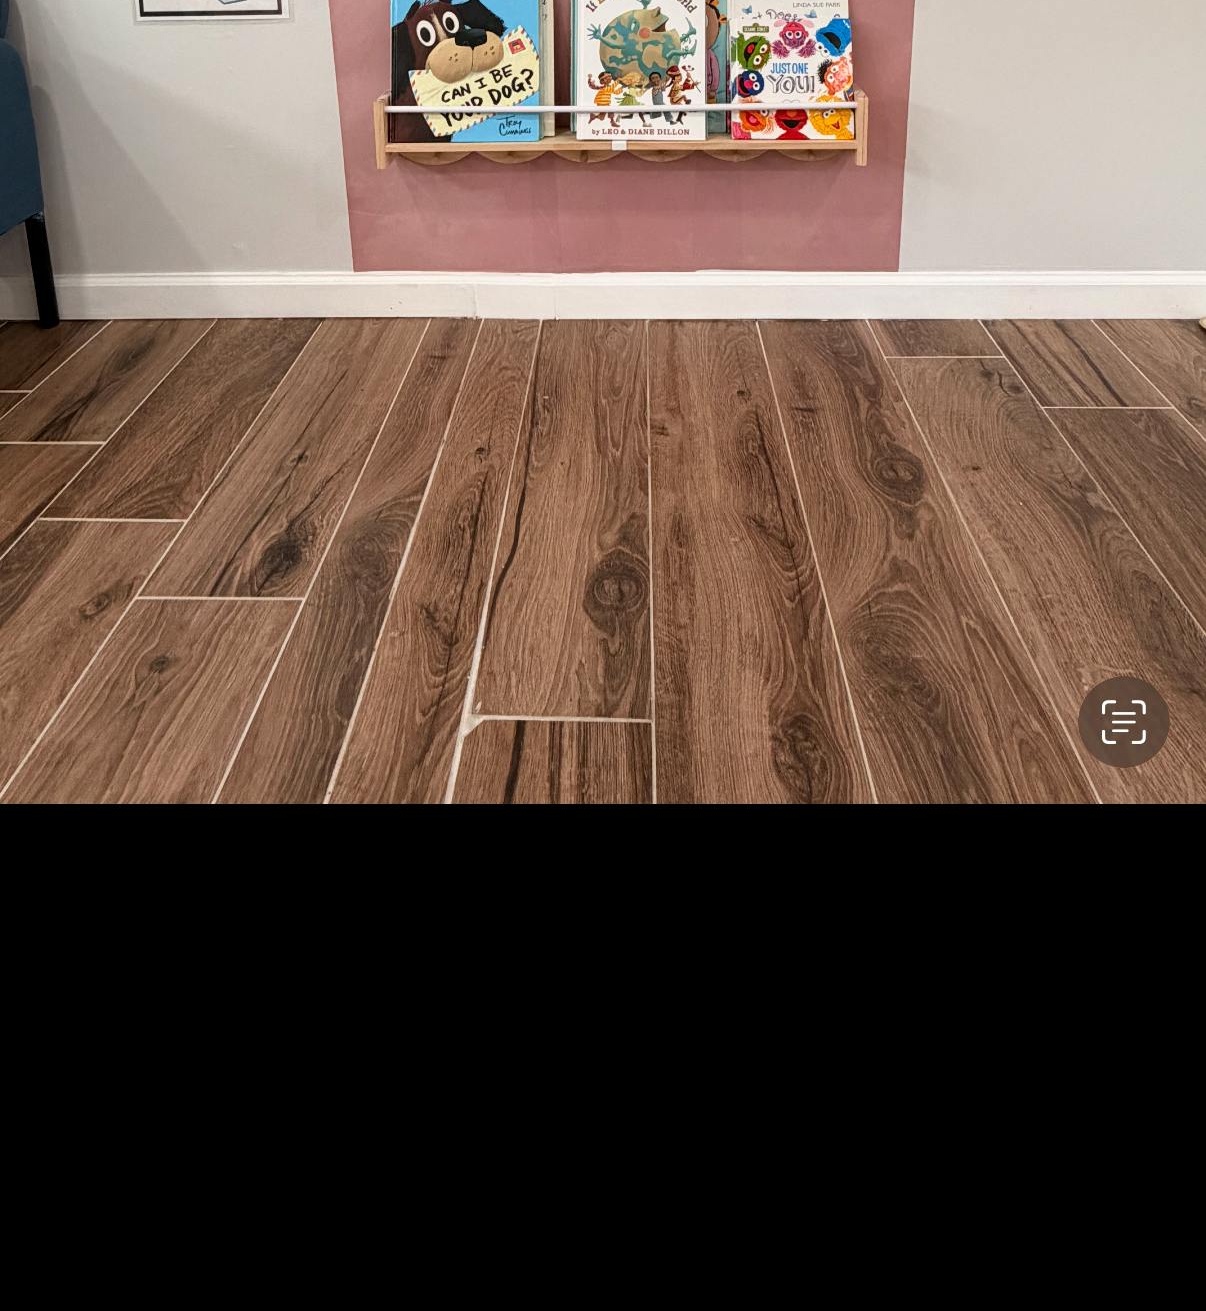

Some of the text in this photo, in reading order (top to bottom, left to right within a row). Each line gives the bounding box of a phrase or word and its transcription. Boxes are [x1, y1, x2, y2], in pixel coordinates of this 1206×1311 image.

[585, 1, 598, 13] If
[770, 62, 808, 74] JUST ONE
[441, 64, 513, 103] CAN I BE
[488, 68, 534, 105] DOG?
[766, 74, 815, 94] YOU!
[591, 128, 600, 136] by
